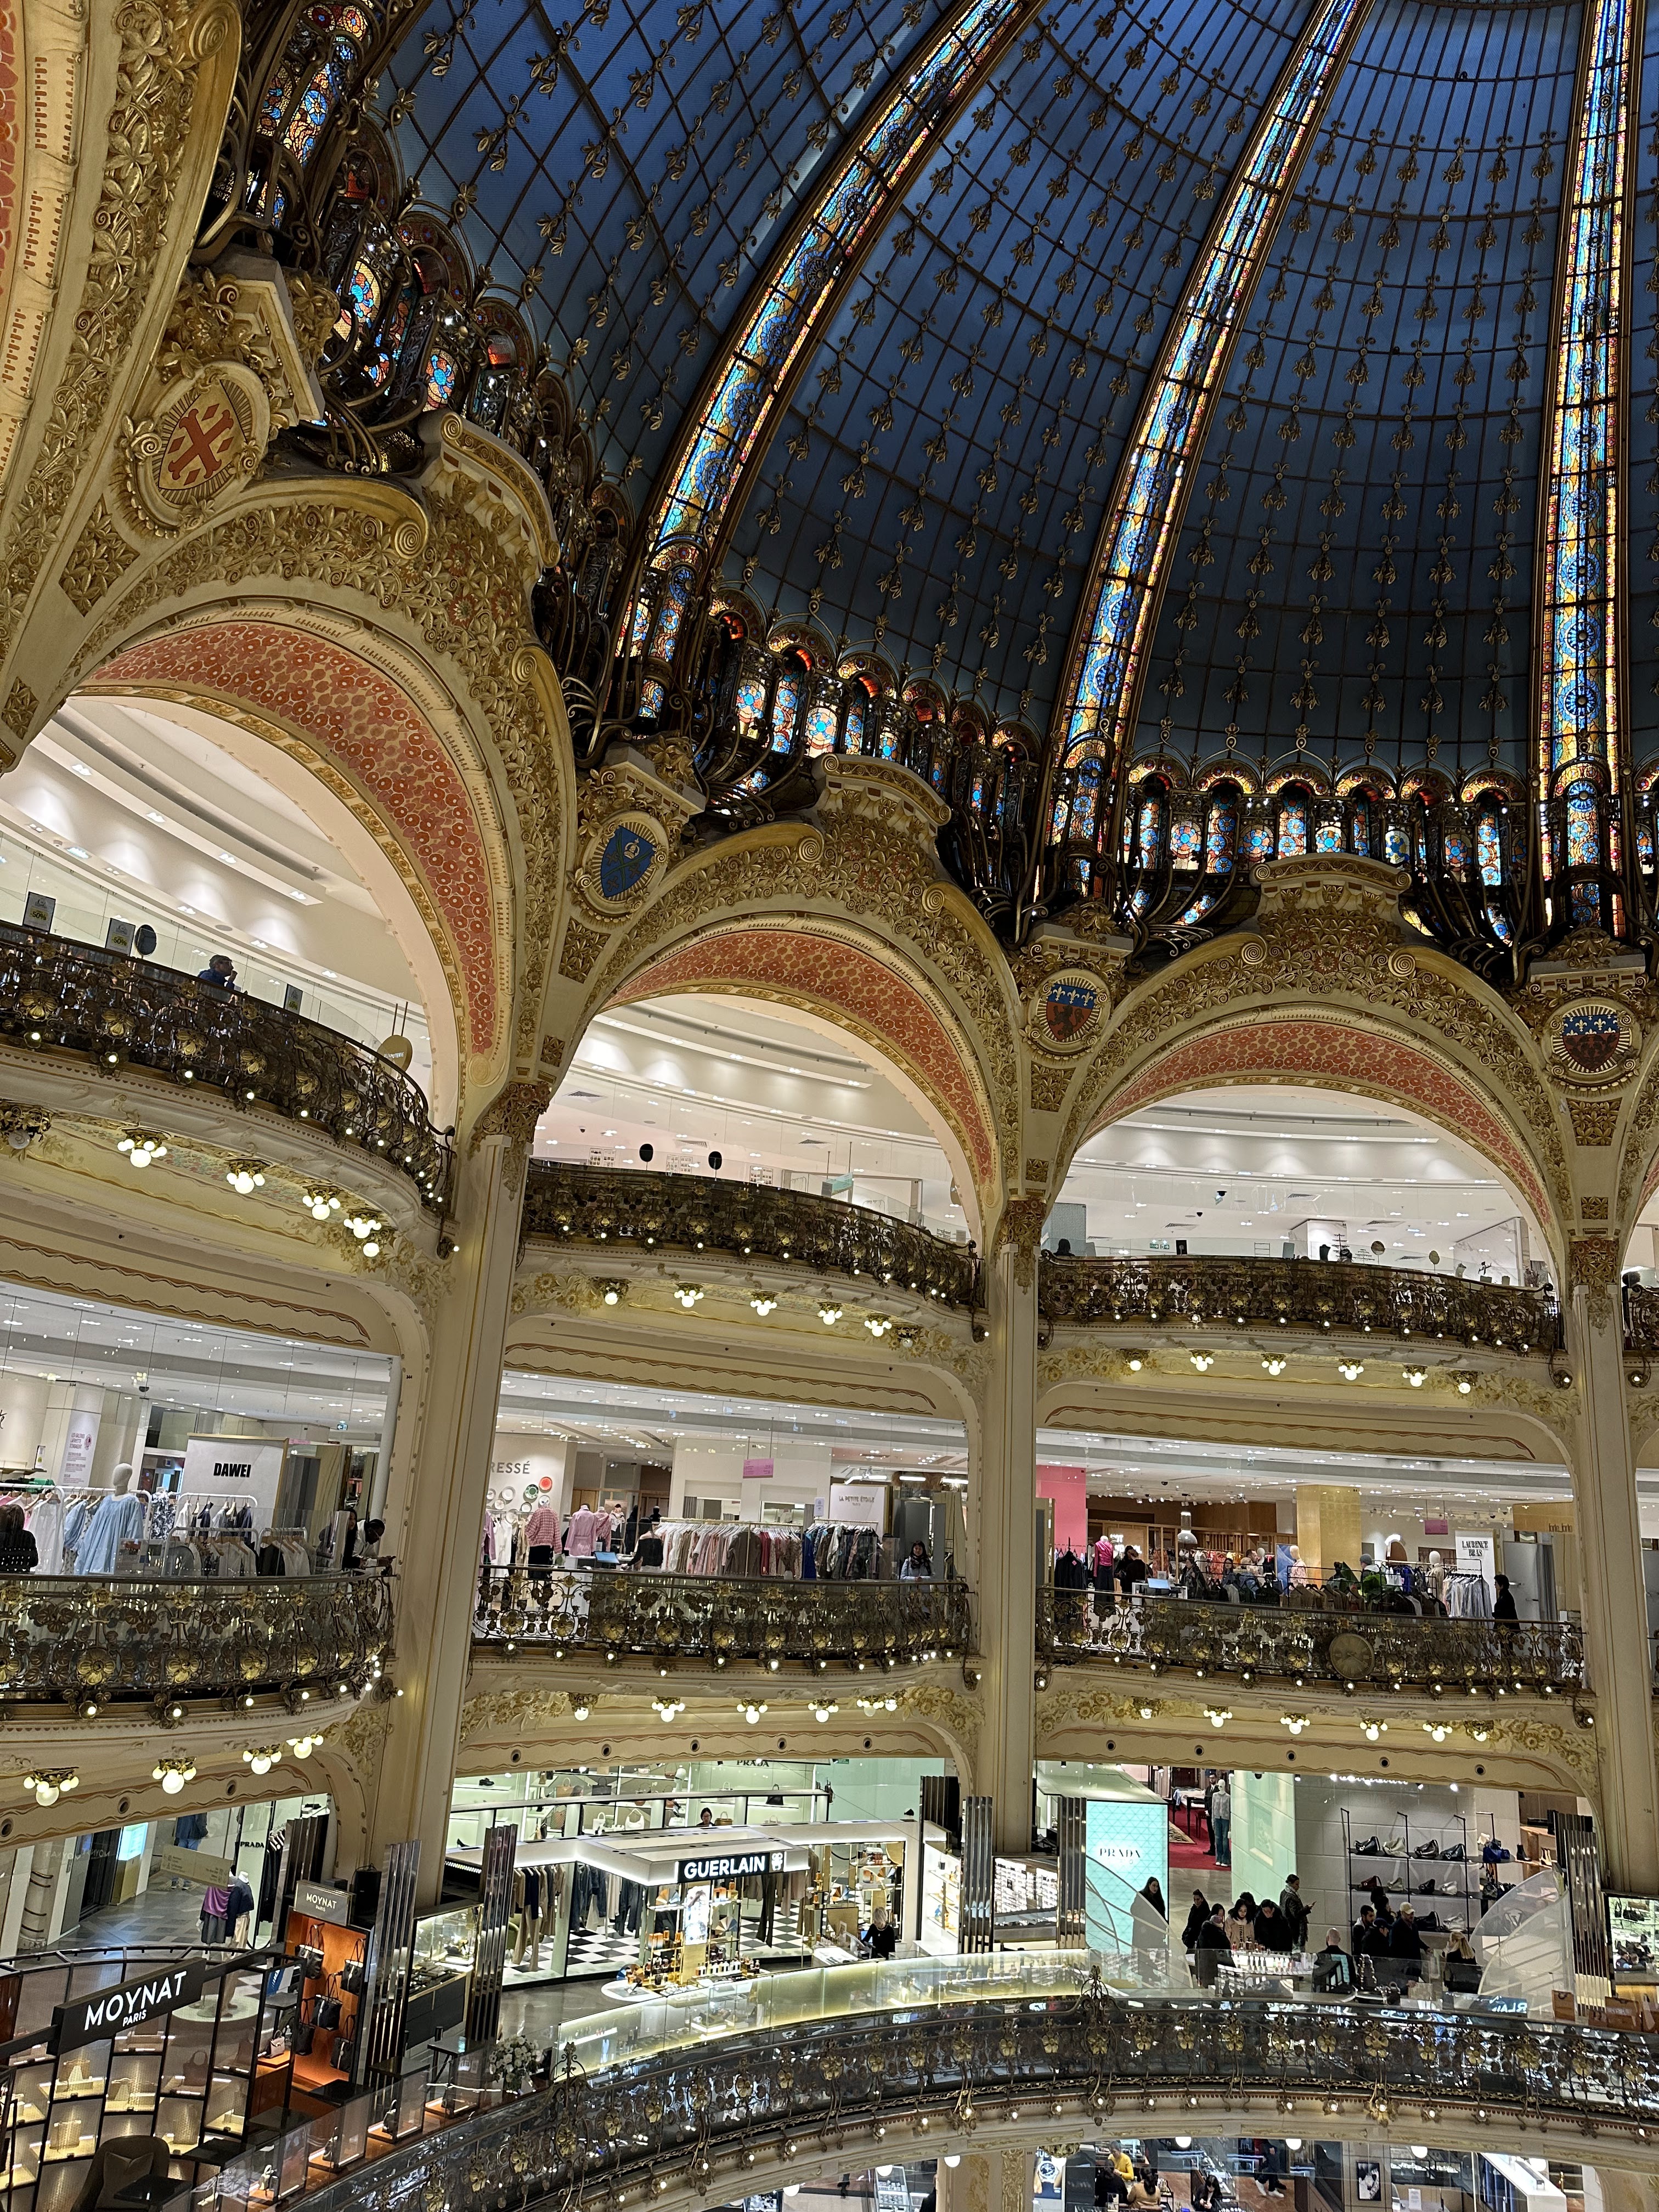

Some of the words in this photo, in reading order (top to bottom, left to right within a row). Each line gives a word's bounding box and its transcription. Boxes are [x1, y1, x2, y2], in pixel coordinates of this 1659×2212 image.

[111, 936, 127, 946] -50%
[213, 1463, 251, 1477] DAWEI
[1100, 1848, 1141, 1858] PRADA
[684, 1855, 765, 1879] GUERLAIN
[306, 1893, 337, 1909] MOYNAT
[84, 1971, 187, 2030] MOYNAT
[122, 2009, 147, 2027] PARIS
